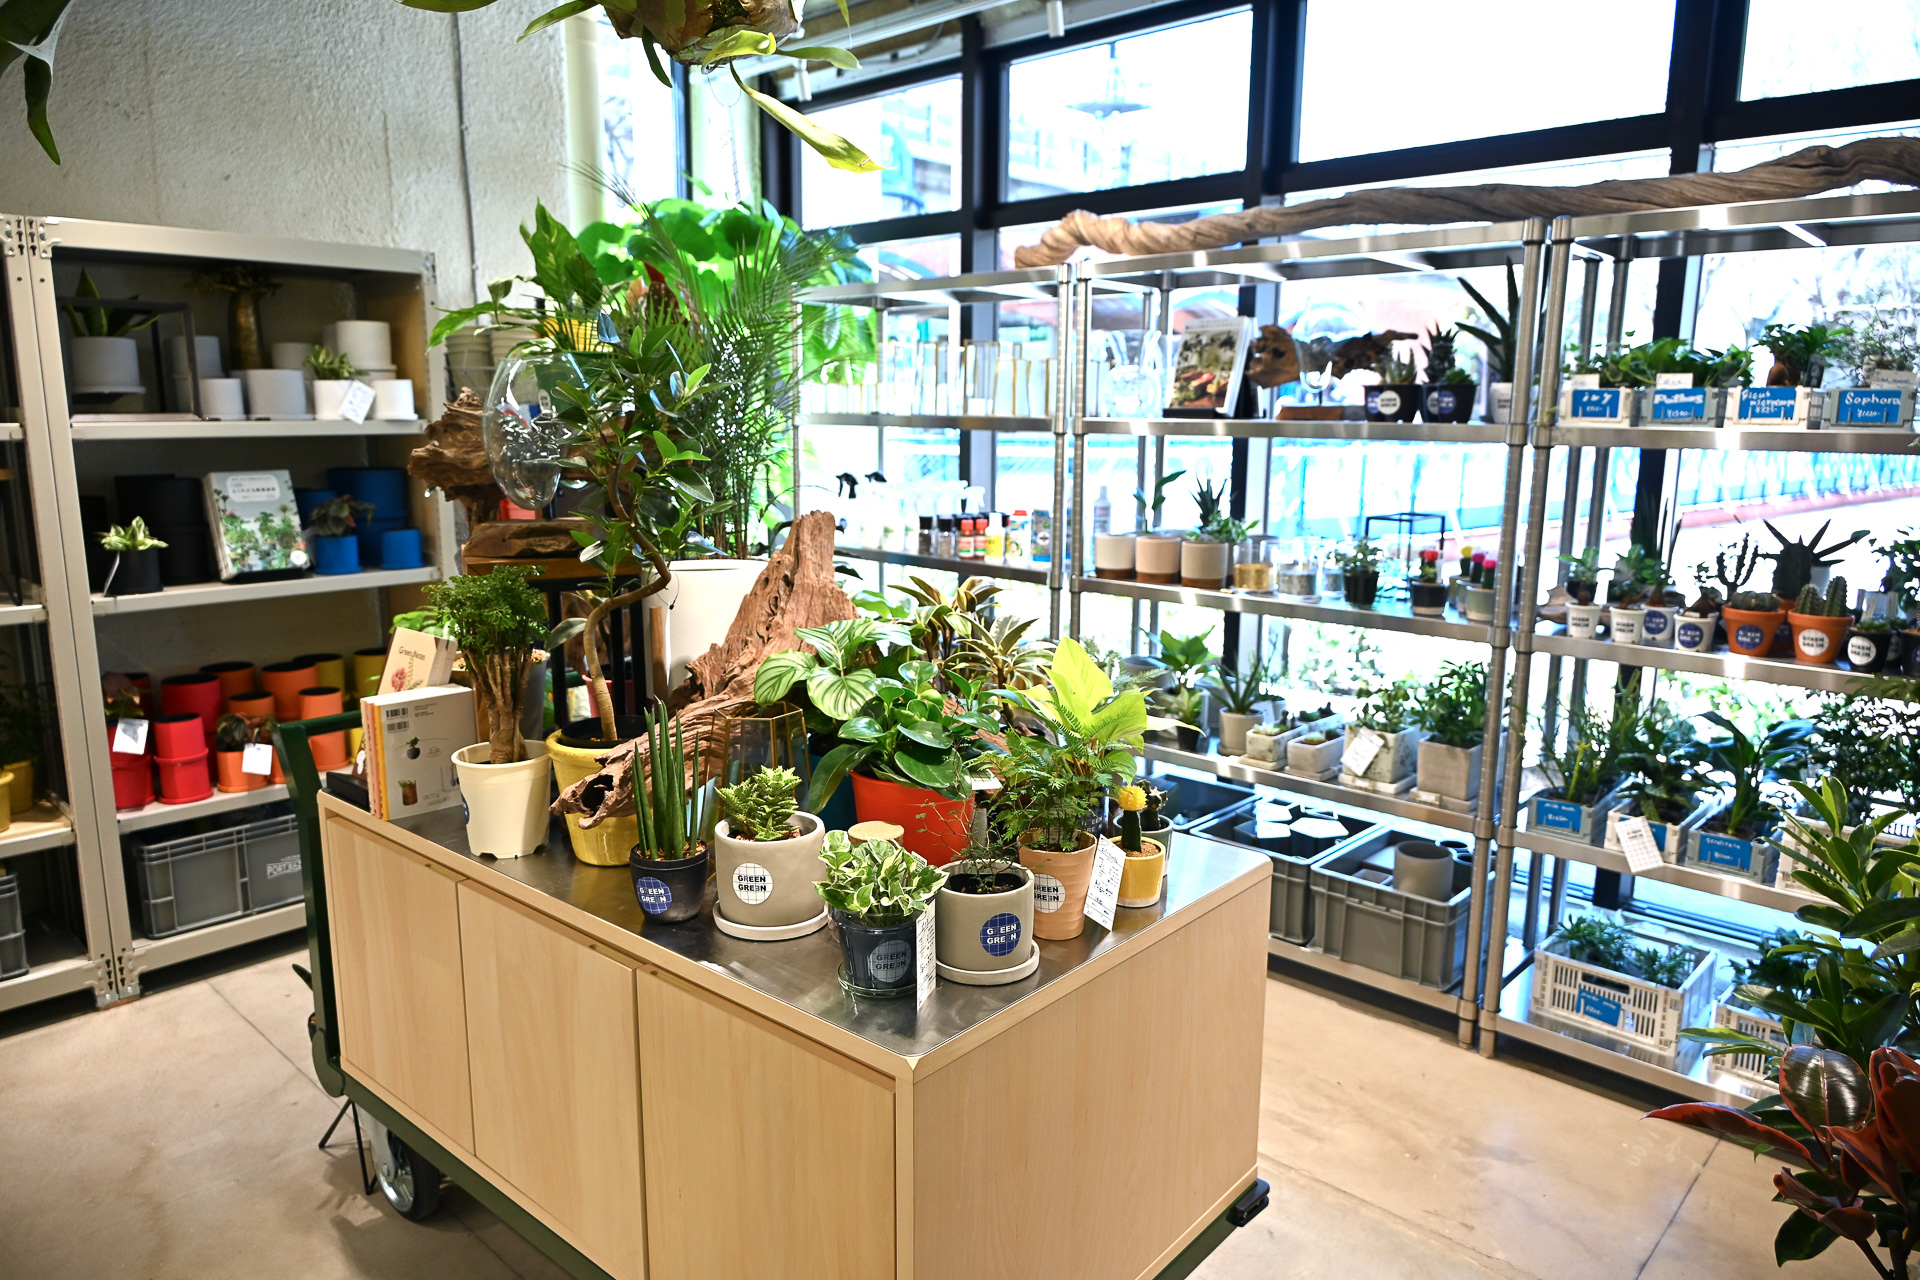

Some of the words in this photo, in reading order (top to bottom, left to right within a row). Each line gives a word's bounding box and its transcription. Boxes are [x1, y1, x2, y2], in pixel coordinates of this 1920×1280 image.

[1845, 391, 1901, 405] Sophora
[876, 951, 907, 962] GREEN
[875, 960, 907, 970] GREEN
